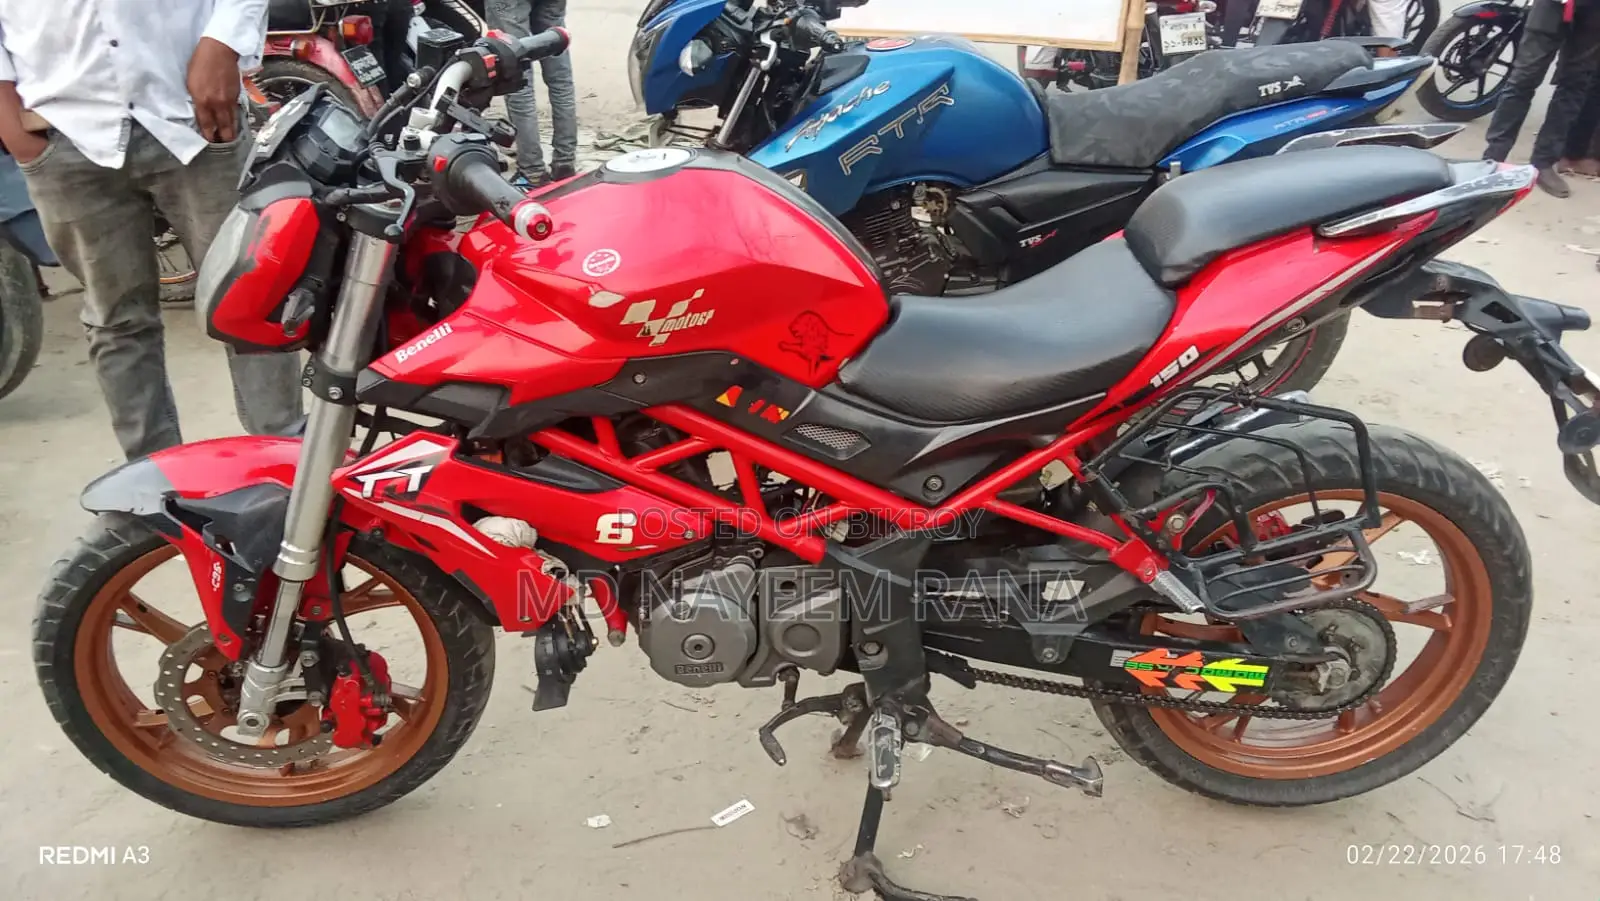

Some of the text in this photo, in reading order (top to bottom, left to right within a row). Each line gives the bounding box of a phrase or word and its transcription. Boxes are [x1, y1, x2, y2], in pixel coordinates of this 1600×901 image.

[1258, 81, 1282, 97] TVS
[784, 79, 892, 153] Apache
[1019, 234, 1042, 248] TVS
[394, 322, 454, 364] Benelli
[1150, 345, 1200, 388] 150
[675, 662, 723, 675] Benelli
